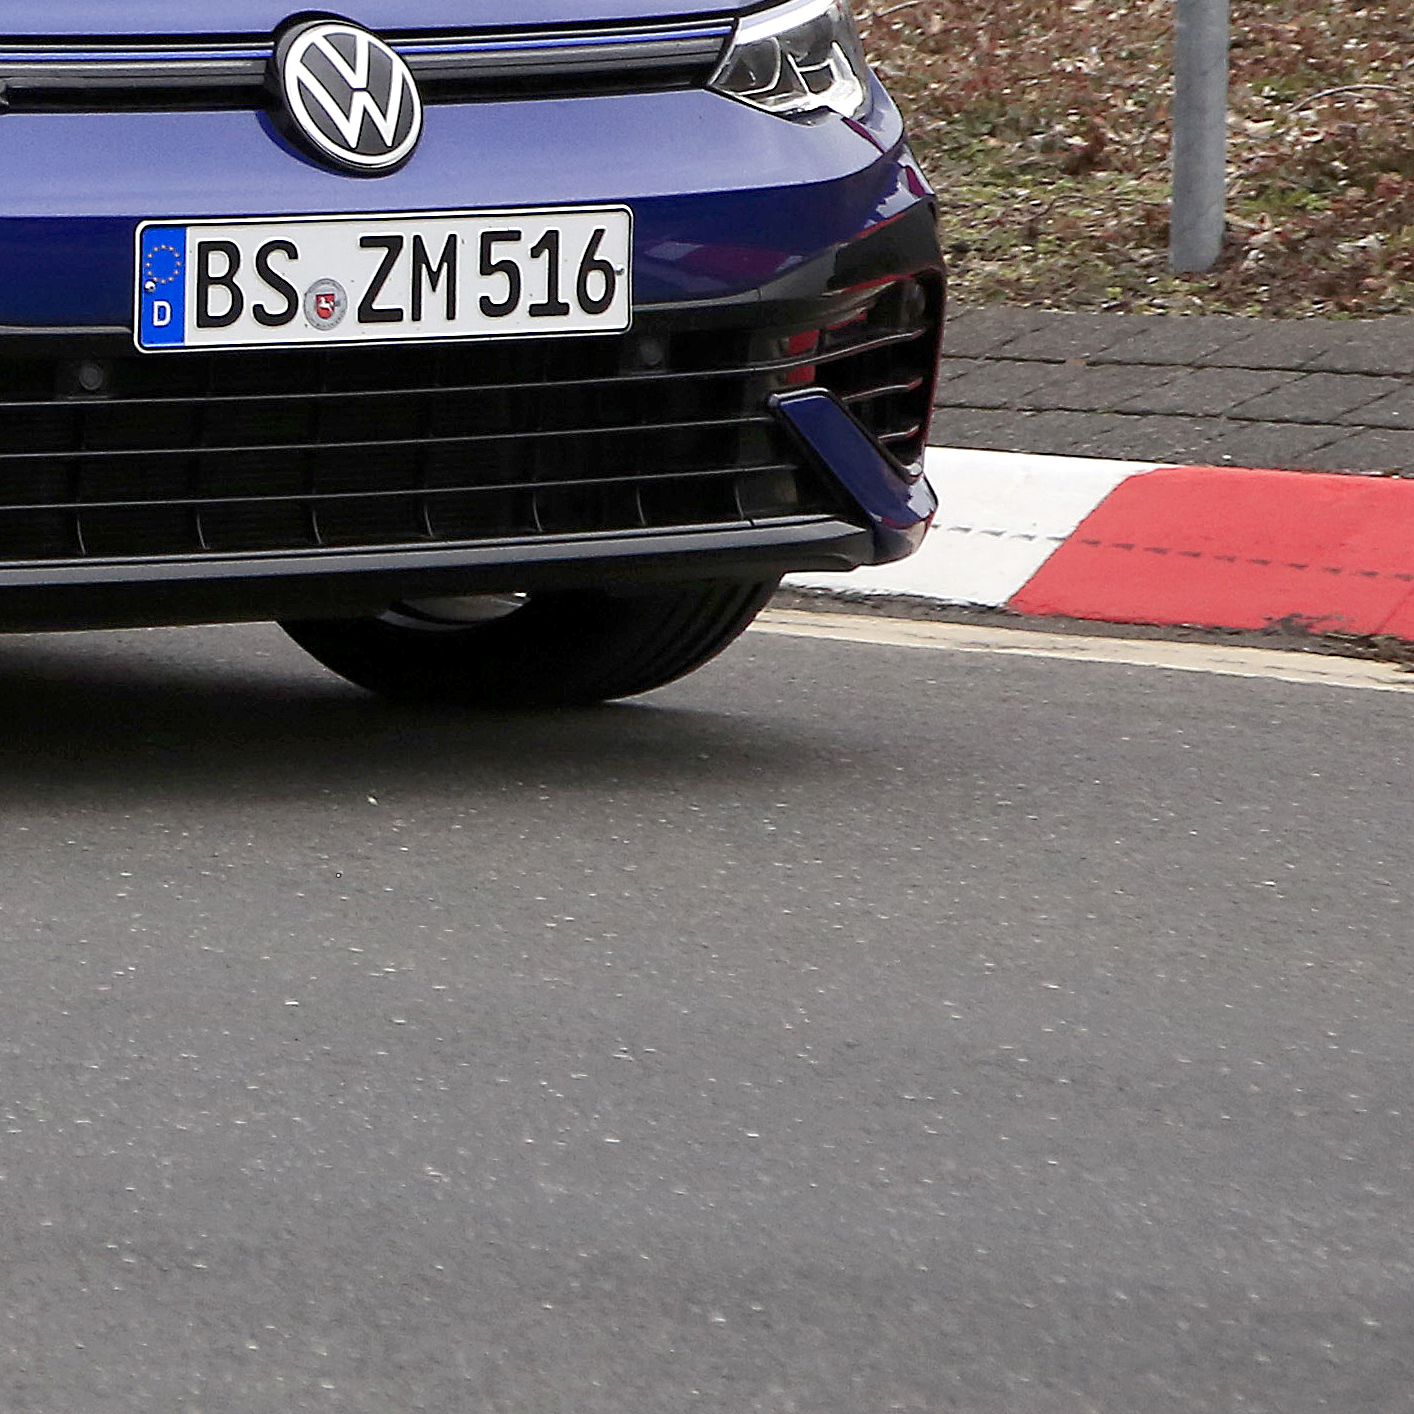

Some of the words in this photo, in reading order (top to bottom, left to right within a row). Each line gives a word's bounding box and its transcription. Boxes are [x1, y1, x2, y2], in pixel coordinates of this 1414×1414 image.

[284, 23, 423, 166] VW
[151, 300, 171, 327] D
[194, 238, 300, 329] BS
[357, 233, 457, 324] ZM
[477, 227, 618, 318] 516
